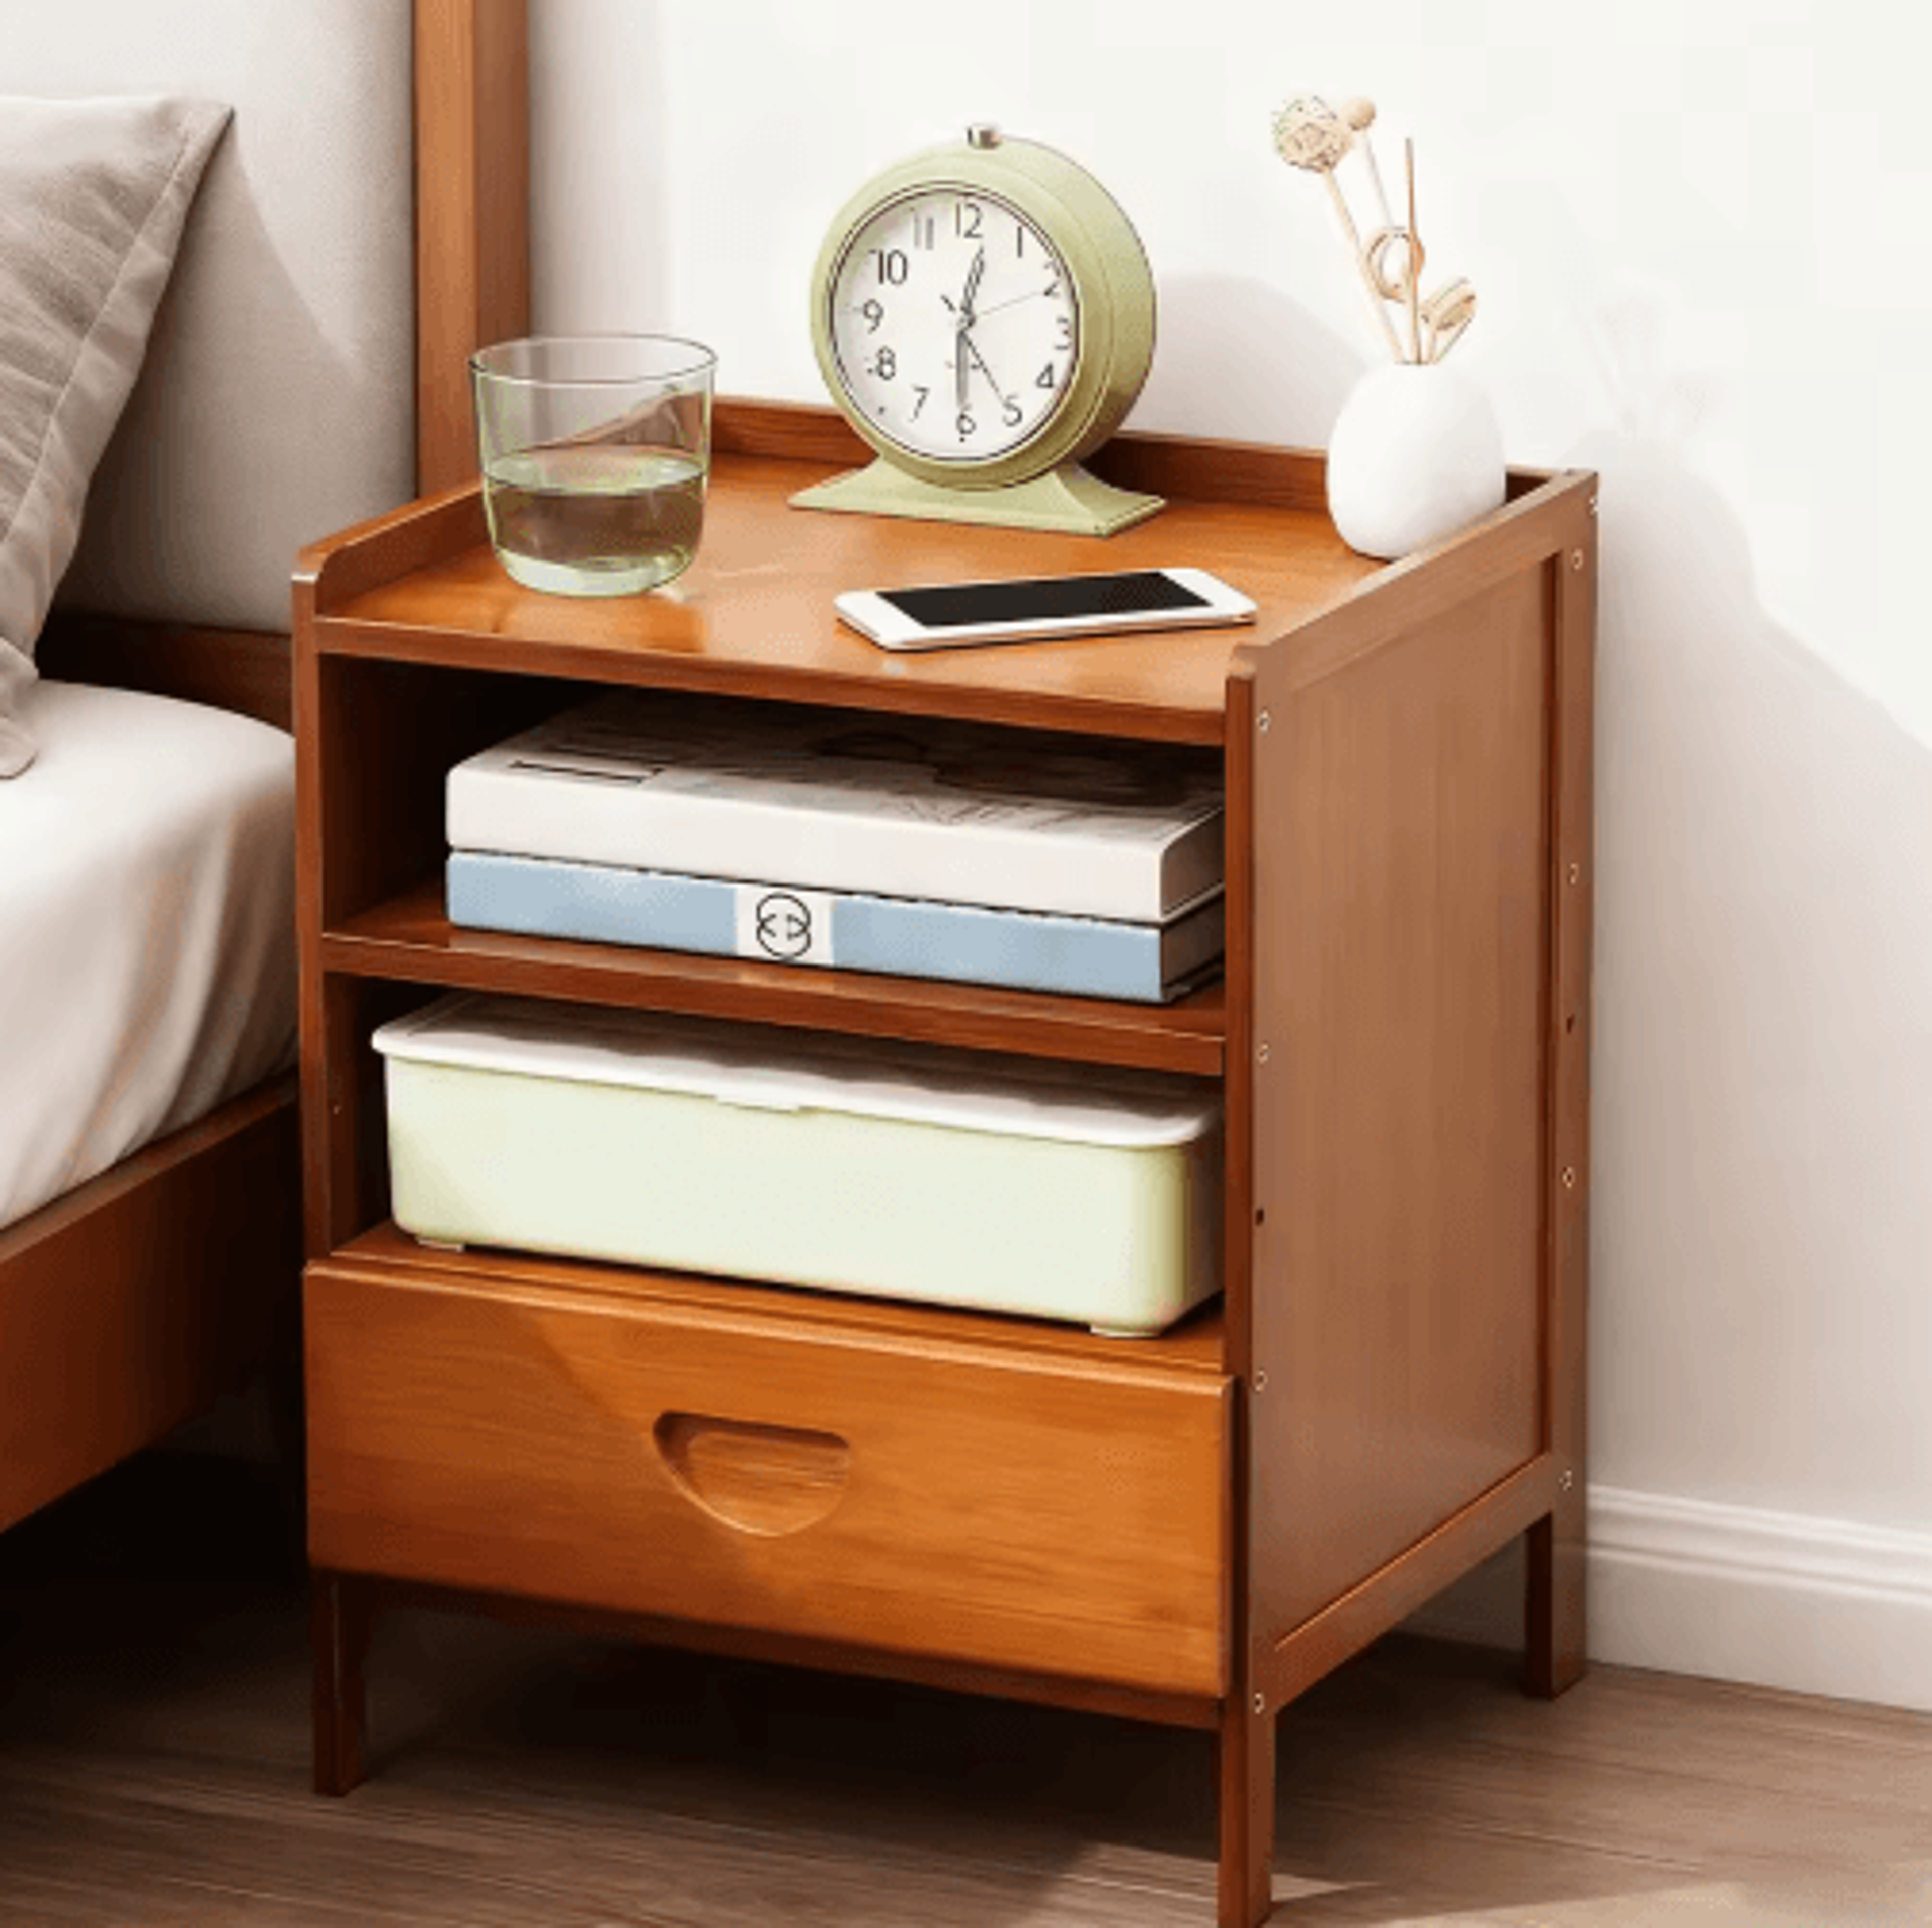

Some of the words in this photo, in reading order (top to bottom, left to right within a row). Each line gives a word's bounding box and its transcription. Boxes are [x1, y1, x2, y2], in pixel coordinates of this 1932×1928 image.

[956, 202, 983, 238] 12
[1017, 225, 1023, 258] 1
[878, 249, 907, 285] 10
[863, 299, 883, 334] 9
[1054, 317, 1071, 350] 3
[876, 346, 896, 381] 8
[1035, 362, 1055, 389] 4
[910, 385, 929, 423] 7
[956, 405, 977, 435] 6
[1002, 394, 1023, 427] 5
